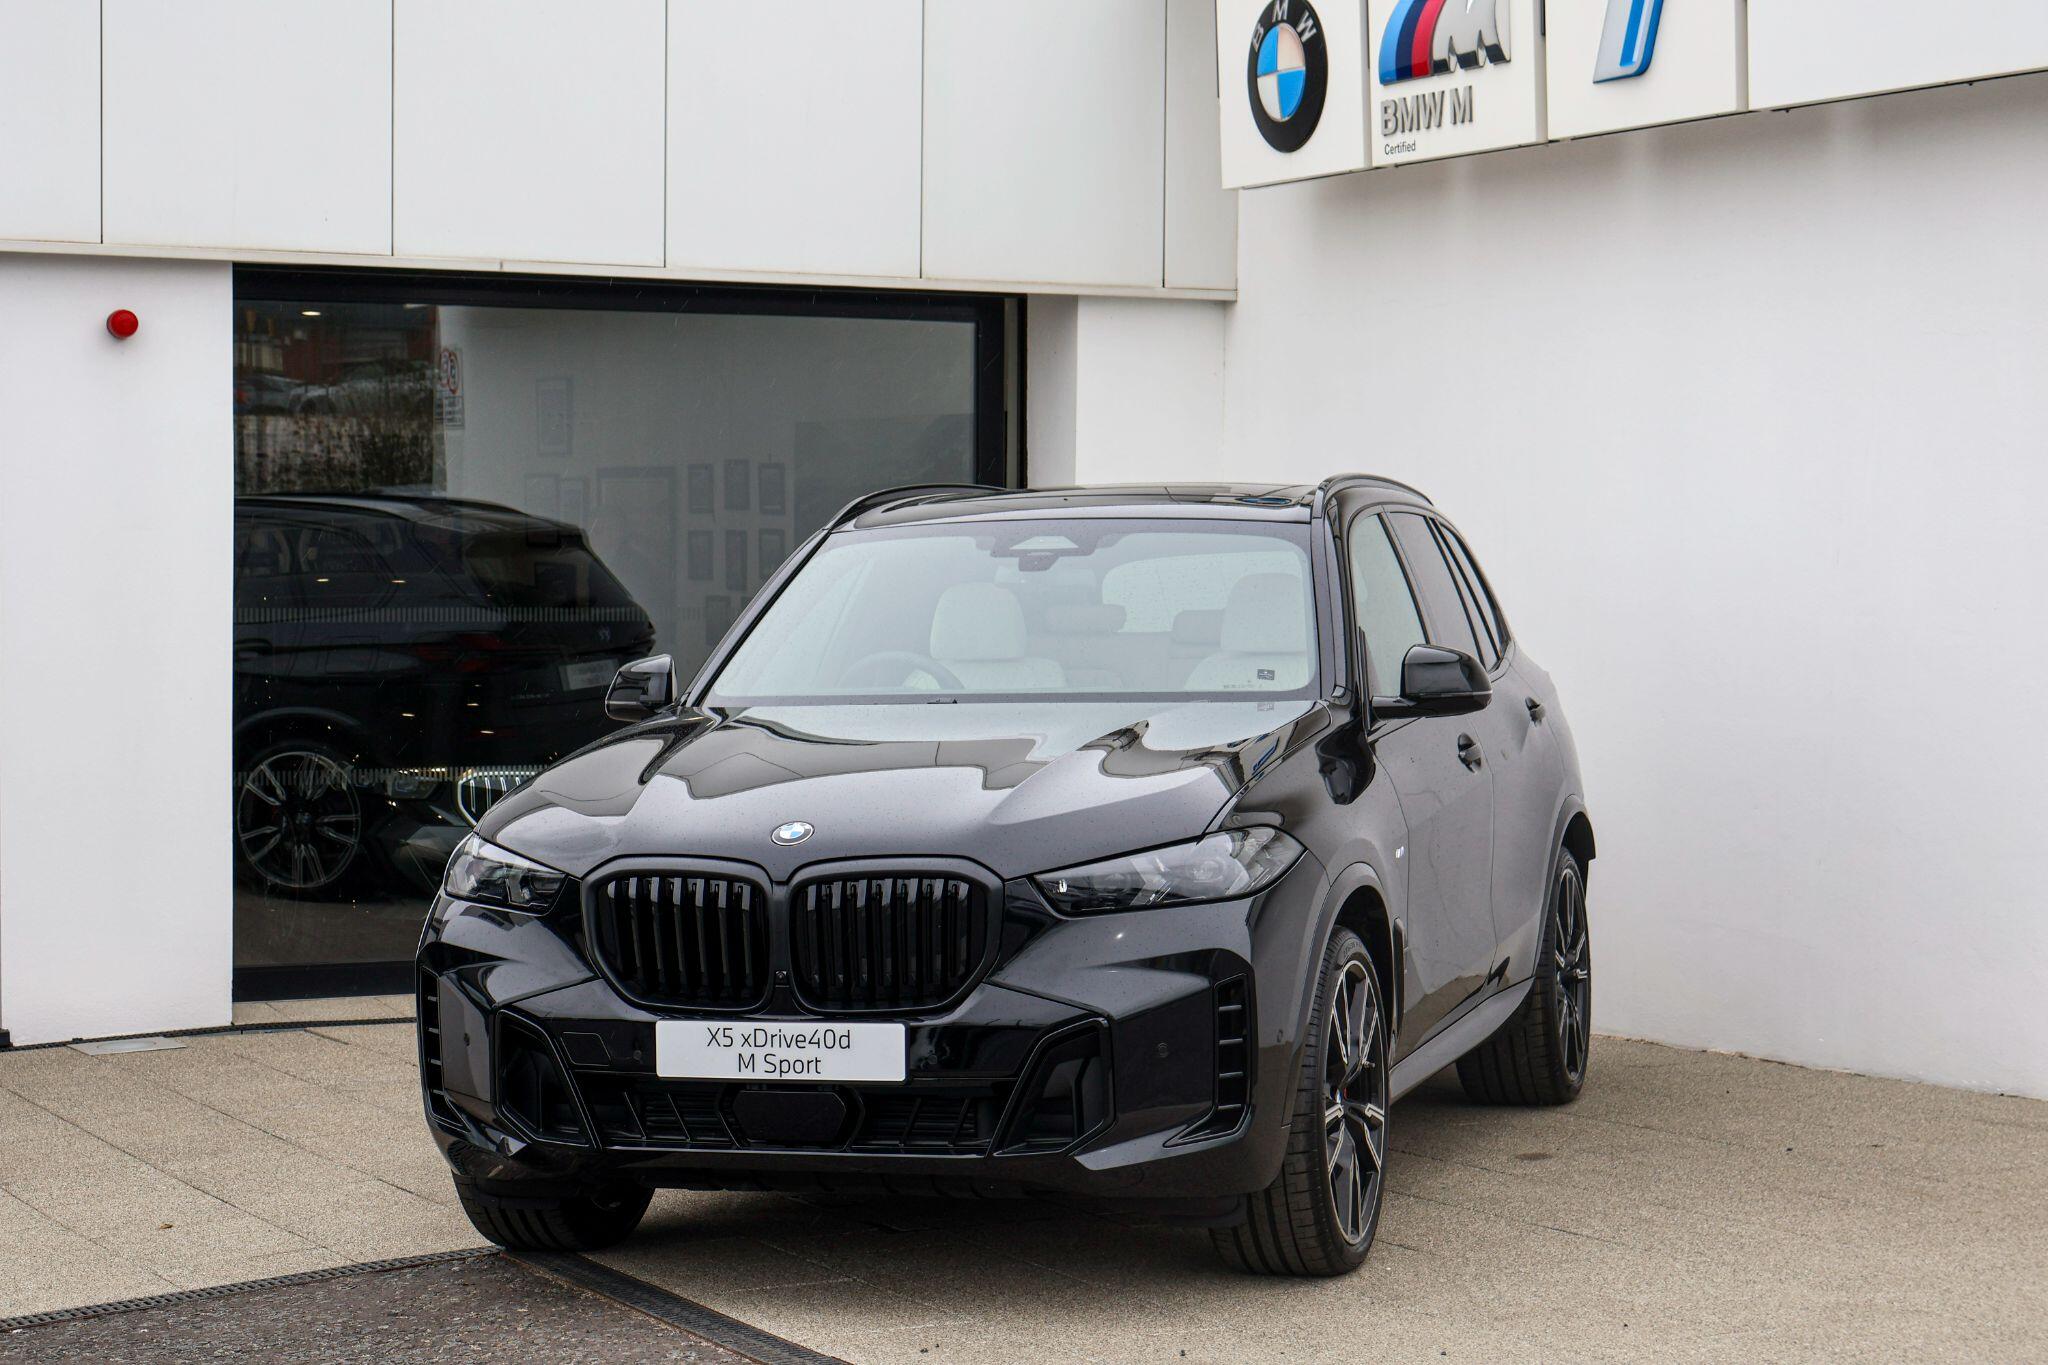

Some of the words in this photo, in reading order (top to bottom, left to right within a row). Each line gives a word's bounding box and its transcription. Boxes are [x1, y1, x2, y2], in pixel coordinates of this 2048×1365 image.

[1252, 0, 1317, 52] BMW
[1380, 90, 1445, 136] BMW
[1449, 85, 1473, 125] M
[1384, 140, 1416, 155] Certified
[707, 1027, 734, 1047] X5
[741, 1029, 851, 1049] xDrive40d
[738, 1054, 755, 1072] M
[764, 1054, 822, 1077] Sport
